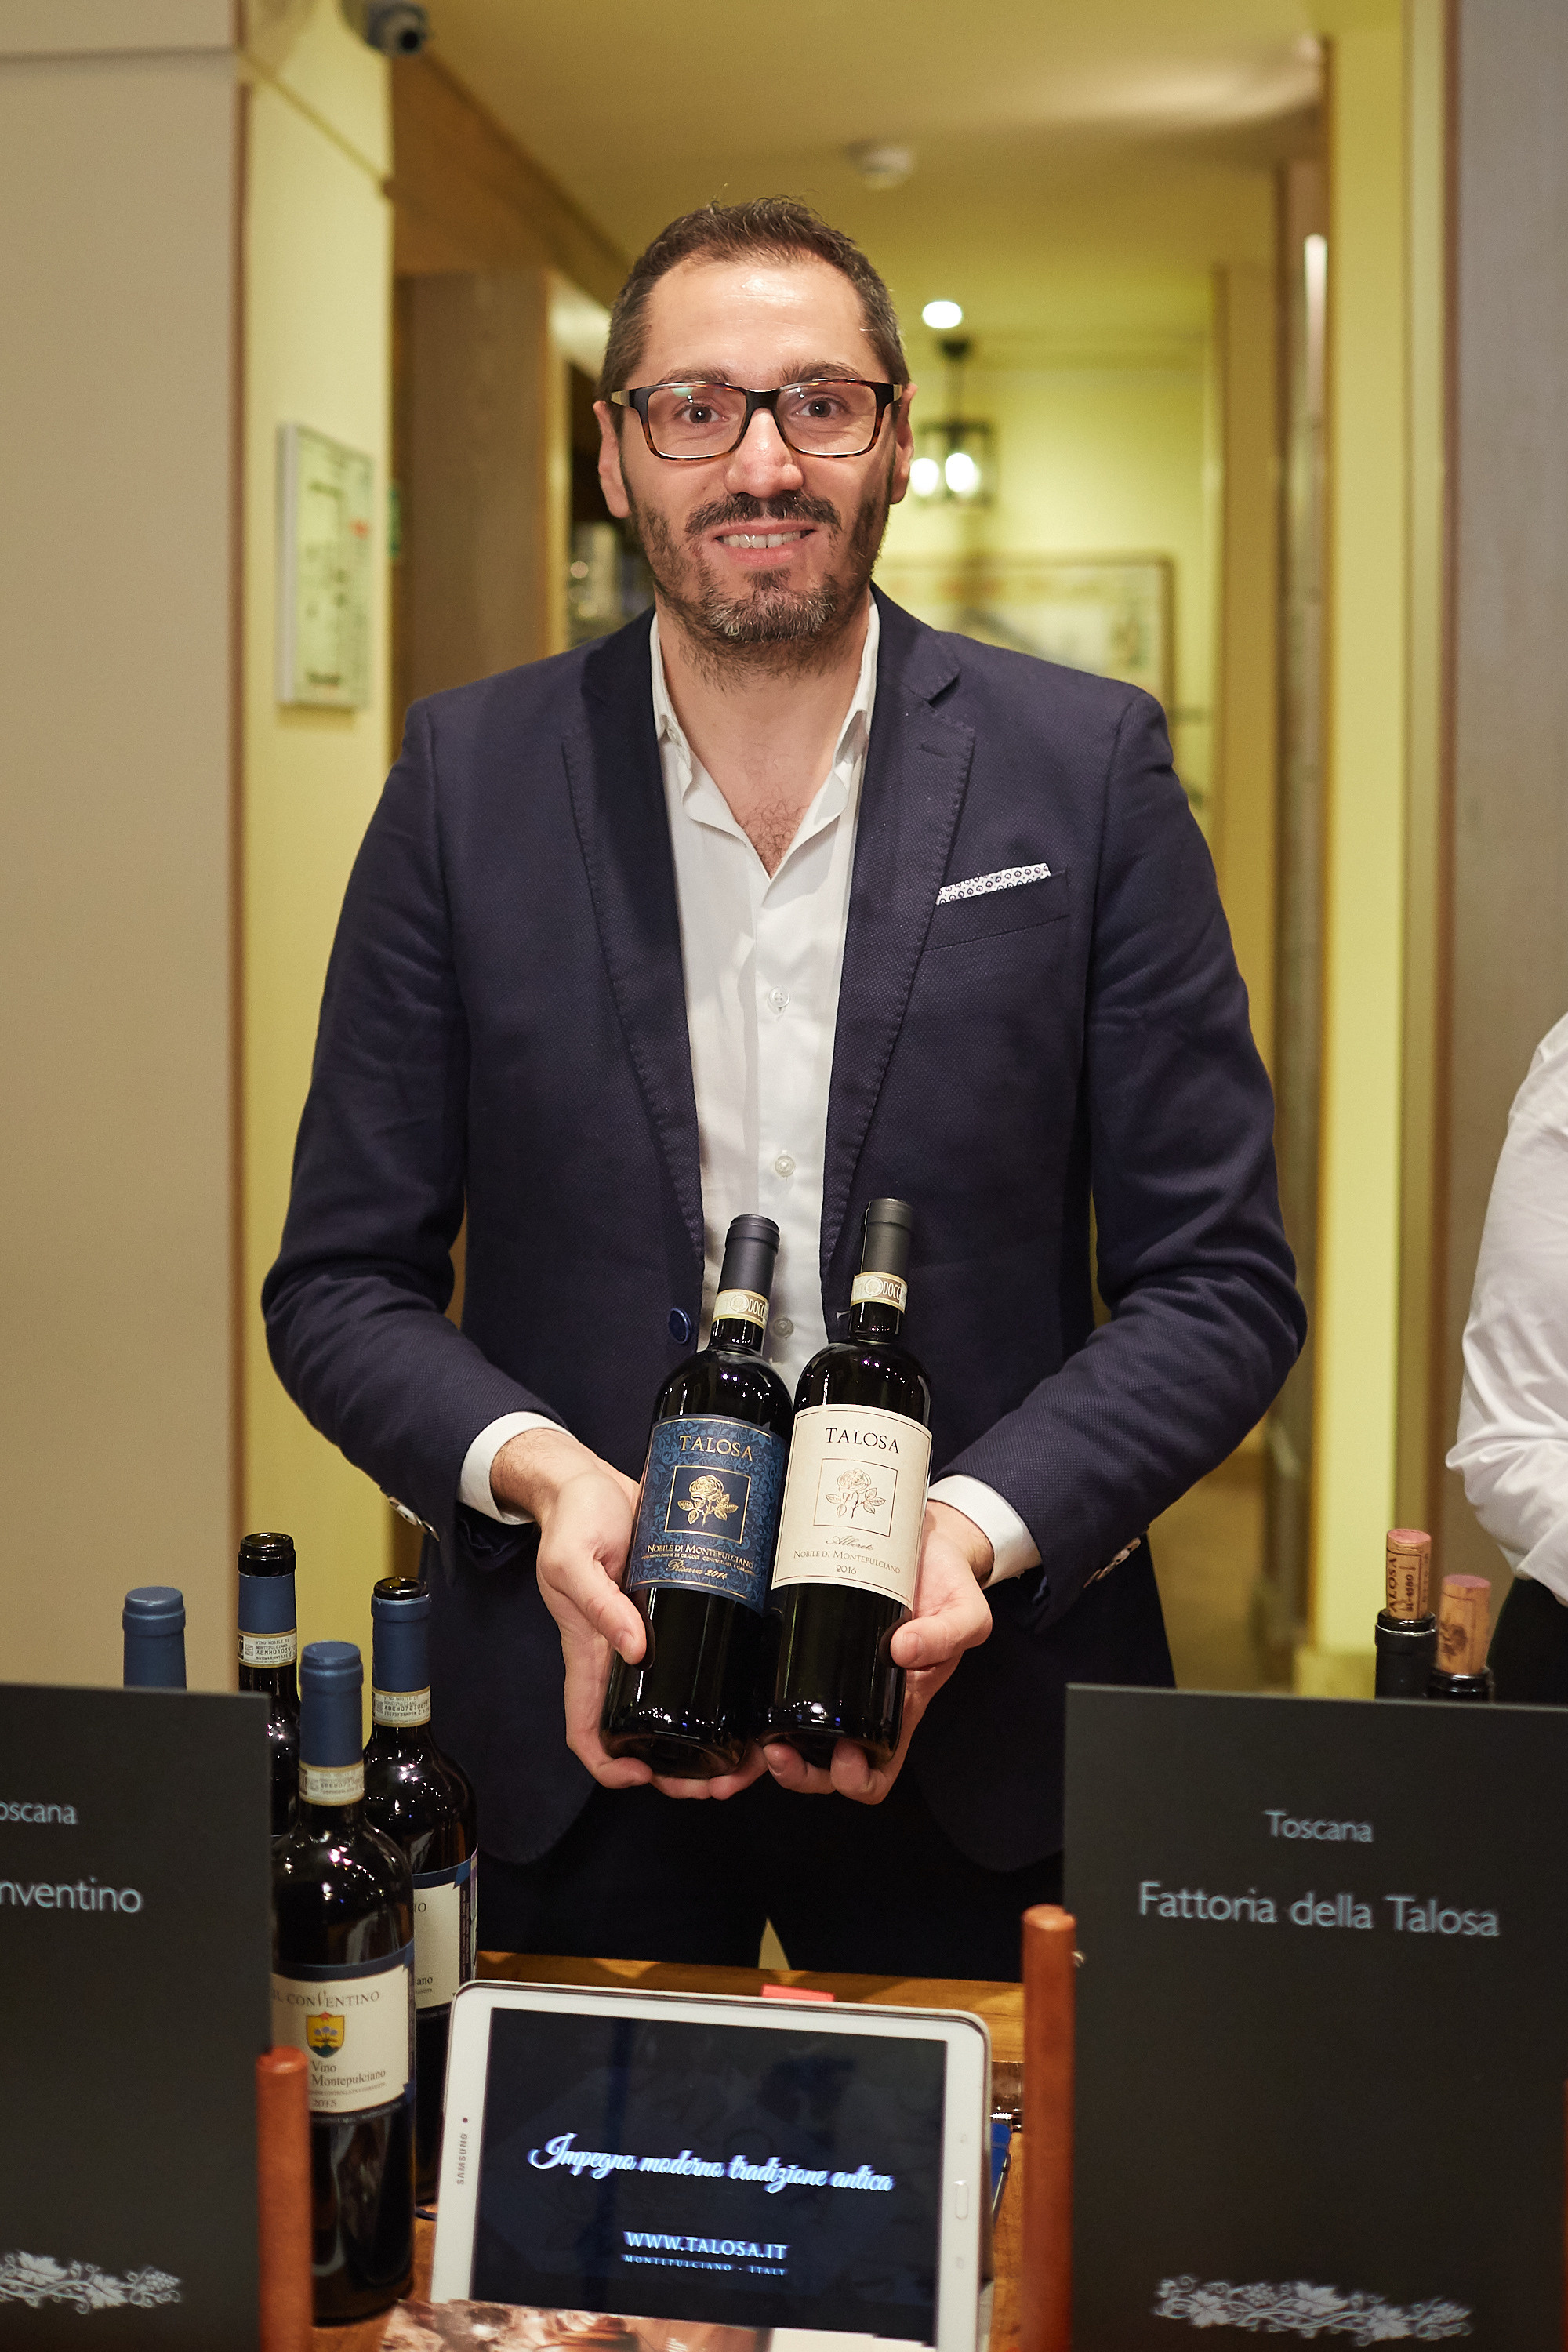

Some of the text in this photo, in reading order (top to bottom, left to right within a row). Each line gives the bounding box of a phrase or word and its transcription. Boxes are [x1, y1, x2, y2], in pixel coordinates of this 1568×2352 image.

[679, 1435, 753, 1462] TALOSA
[826, 1428, 899, 1454] TALOSA
[647, 1544, 673, 1553] NOBILE
[684, 1544, 754, 1569] MONTEPULCIANO
[793, 1550, 819, 1559] NOBILE
[833, 1550, 901, 1574] MONTEPULCIANO
[665, 1559, 728, 1580] Riserva 2014
[836, 1564, 857, 1575] 2016
[1263, 1808, 1374, 1843] Toscana
[0, 1876, 143, 1913] nventino
[1138, 1881, 1501, 1937] Fattoria della Talosa
[287, 1990, 379, 2008] CONVENTINO
[311, 2061, 336, 2073] Vino
[312, 2070, 386, 2088] Montepulciano
[456, 2133, 468, 2186] SAMSUNG
[528, 2132, 895, 2194] Impegno moderno tradizione antica
[624, 2231, 789, 2260] WWW.TALOSA.IT
[622, 2254, 787, 2277] MONTEPULCIANO ITALY
